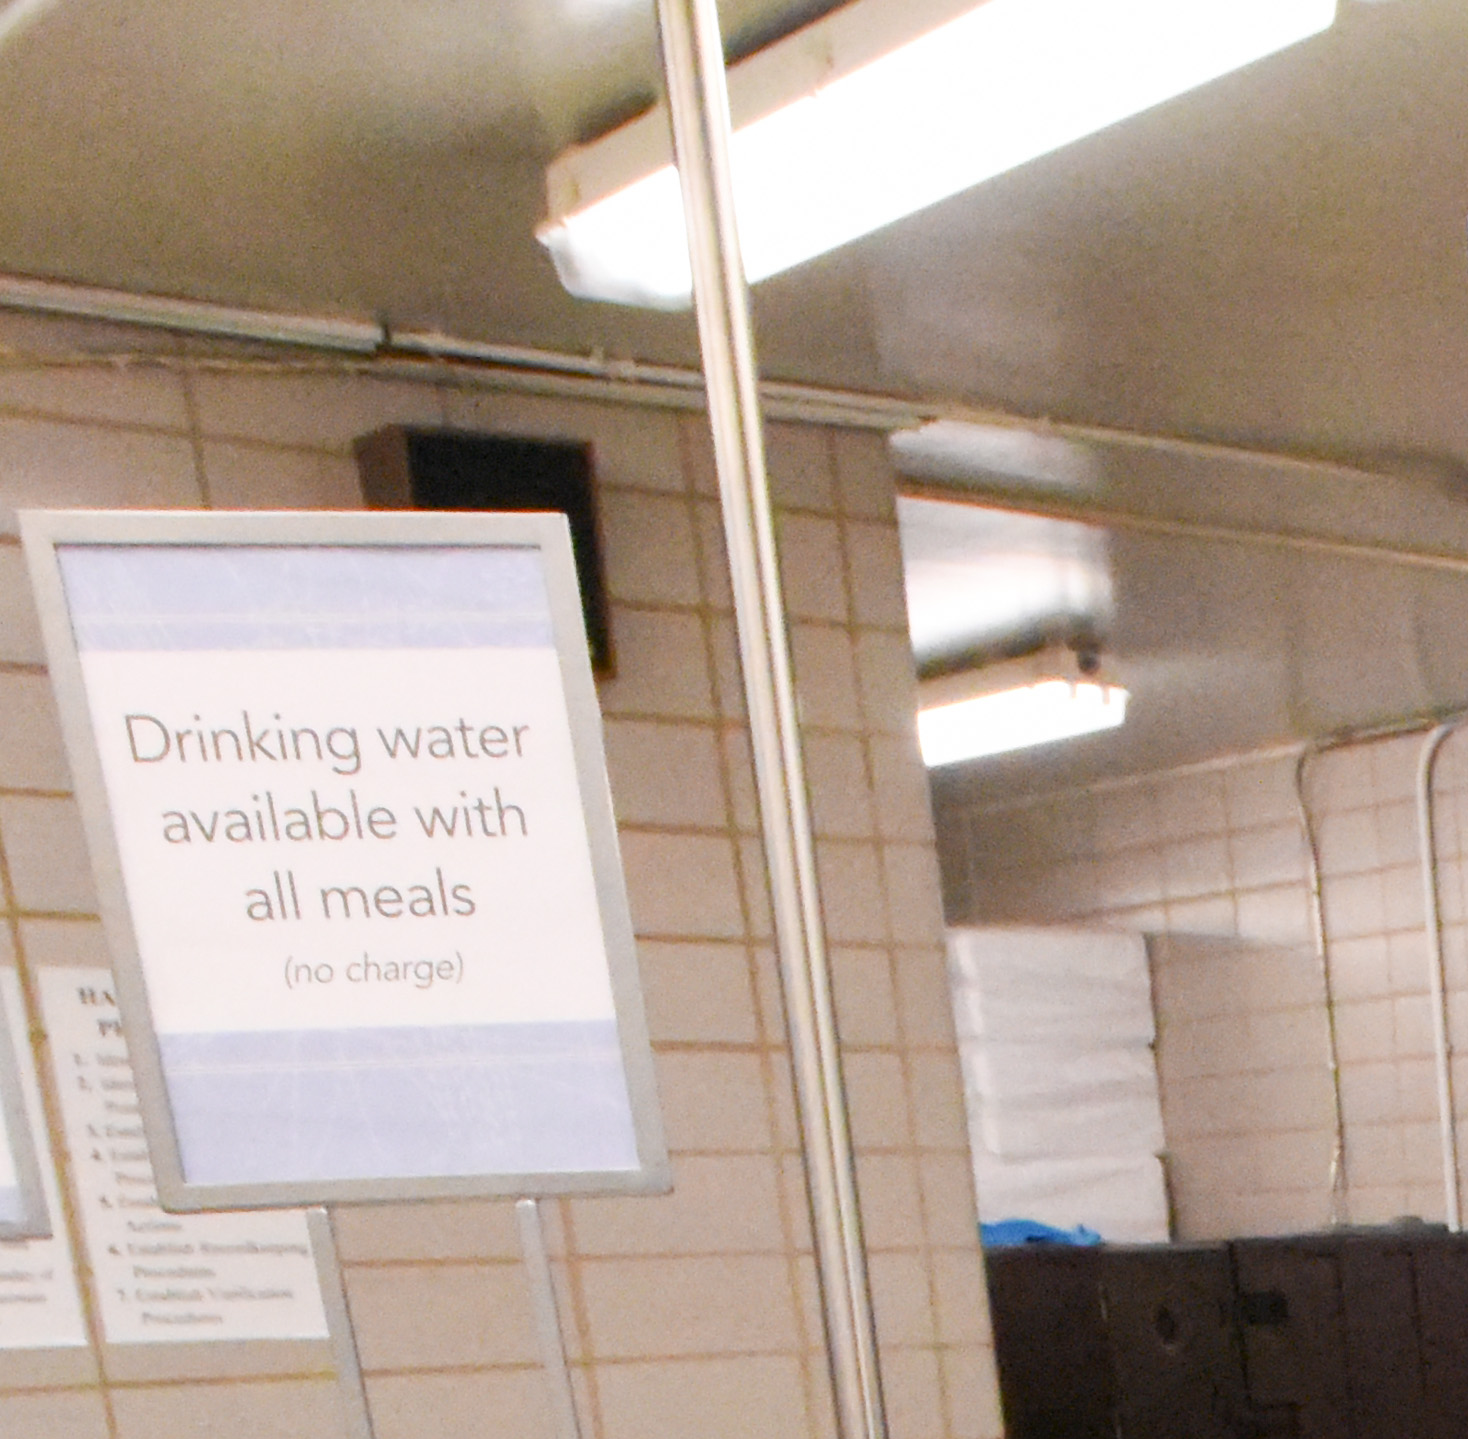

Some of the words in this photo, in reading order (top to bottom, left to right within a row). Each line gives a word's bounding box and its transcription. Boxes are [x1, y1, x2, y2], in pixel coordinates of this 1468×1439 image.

[124, 709, 361, 774] Drinking
[378, 717, 530, 760] water
[162, 791, 397, 843] available
[414, 788, 528, 839] with
[245, 869, 301, 921] all
[320, 868, 476, 918] meals
[284, 955, 333, 988] (no
[346, 951, 464, 988] charge)
